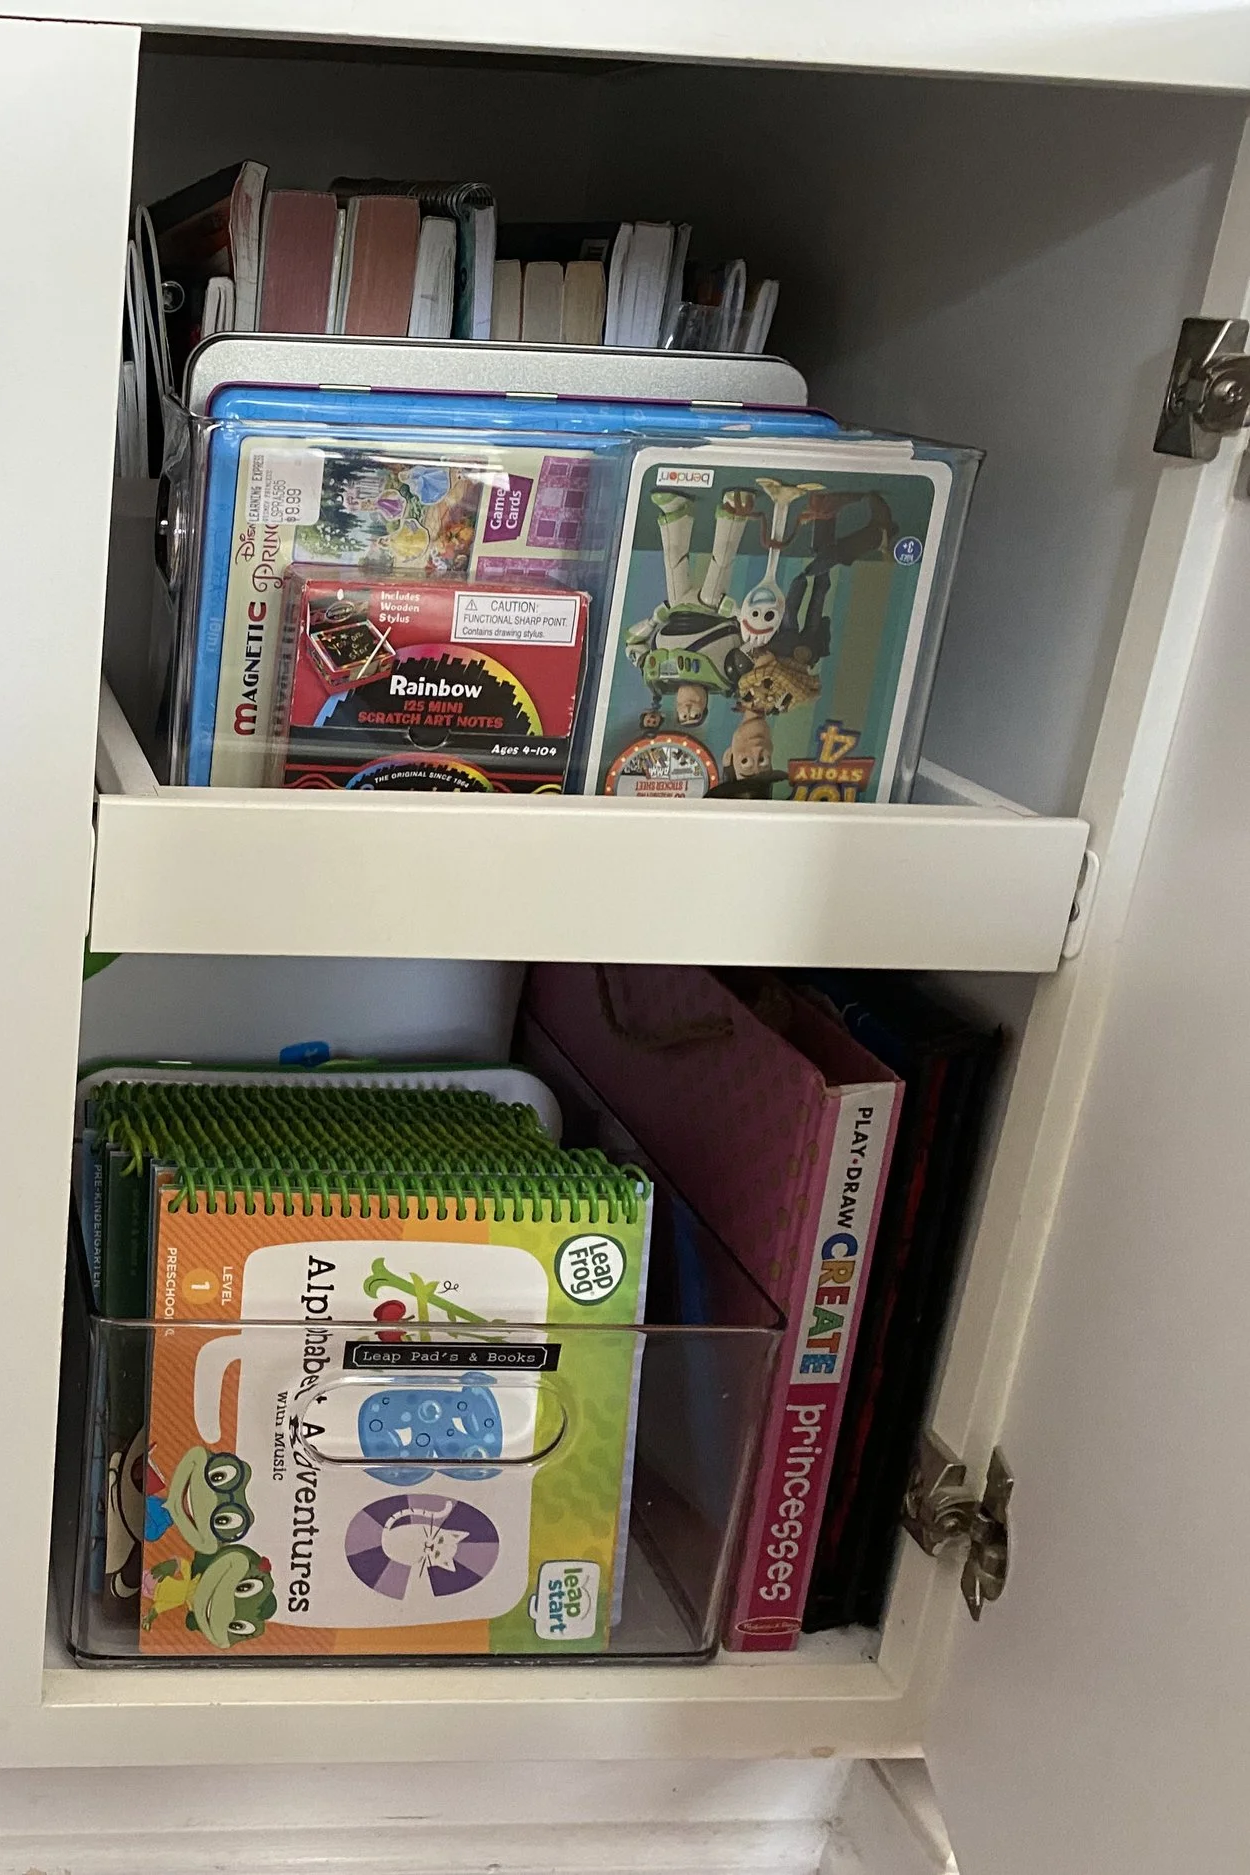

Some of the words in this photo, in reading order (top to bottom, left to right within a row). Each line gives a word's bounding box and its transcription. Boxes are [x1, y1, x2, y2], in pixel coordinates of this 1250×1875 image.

[251, 454, 265, 482] EXPRESS
[659, 471, 711, 486] bendon
[249, 483, 262, 522] LEARNING
[284, 488, 302, 522] $9.99
[490, 489, 506, 530] Game
[506, 490, 522, 529] Cards
[380, 591, 421, 602] Includes
[380, 603, 420, 613] Wooden
[491, 600, 539, 613] CAUTION:
[379, 613, 411, 625] Stylus
[463, 614, 514, 625] FUNCTIONAL
[515, 616, 541, 626] SHARP
[542, 617, 568, 627] POINT.
[462, 626, 493, 637] Contains
[494, 628, 522, 640] drawing
[523, 629, 545, 640] stylus.
[233, 601, 267, 736] MAGNETIC
[390, 675, 482, 698] Rainbow
[403, 700, 425, 713] 125
[428, 701, 464, 713] MINI
[357, 711, 421, 726] SCRATCH
[423, 714, 454, 727] ART
[456, 716, 503, 728] NOTES
[491, 744, 519, 756] Ages
[522, 746, 557, 756] 4-104
[817, 723, 857, 765] 4
[374, 774, 389, 784] THE
[391, 771, 427, 779] ORIGINAL
[429, 772, 452, 782] SINCE
[795, 766, 863, 782] STORY
[655, 780, 684, 792] STICKER
[93, 1164, 103, 1288] PRE-KINDERGARTEN
[568, 1247, 594, 1295] Frog
[589, 1241, 614, 1290] Leap
[190, 1280, 211, 1291] 1
[221, 1266, 234, 1306] LEVEL
[799, 1232, 860, 1375] CREATE
[363, 1351, 402, 1363] Leap
[410, 1351, 459, 1363] Pad's
[468, 1352, 479, 1363] &
[487, 1352, 536, 1364] Books
[272, 1433, 288, 1482] Music
[759, 1404, 827, 1601] princesses
[564, 1568, 584, 1618] leap
[548, 1580, 568, 1633] start
